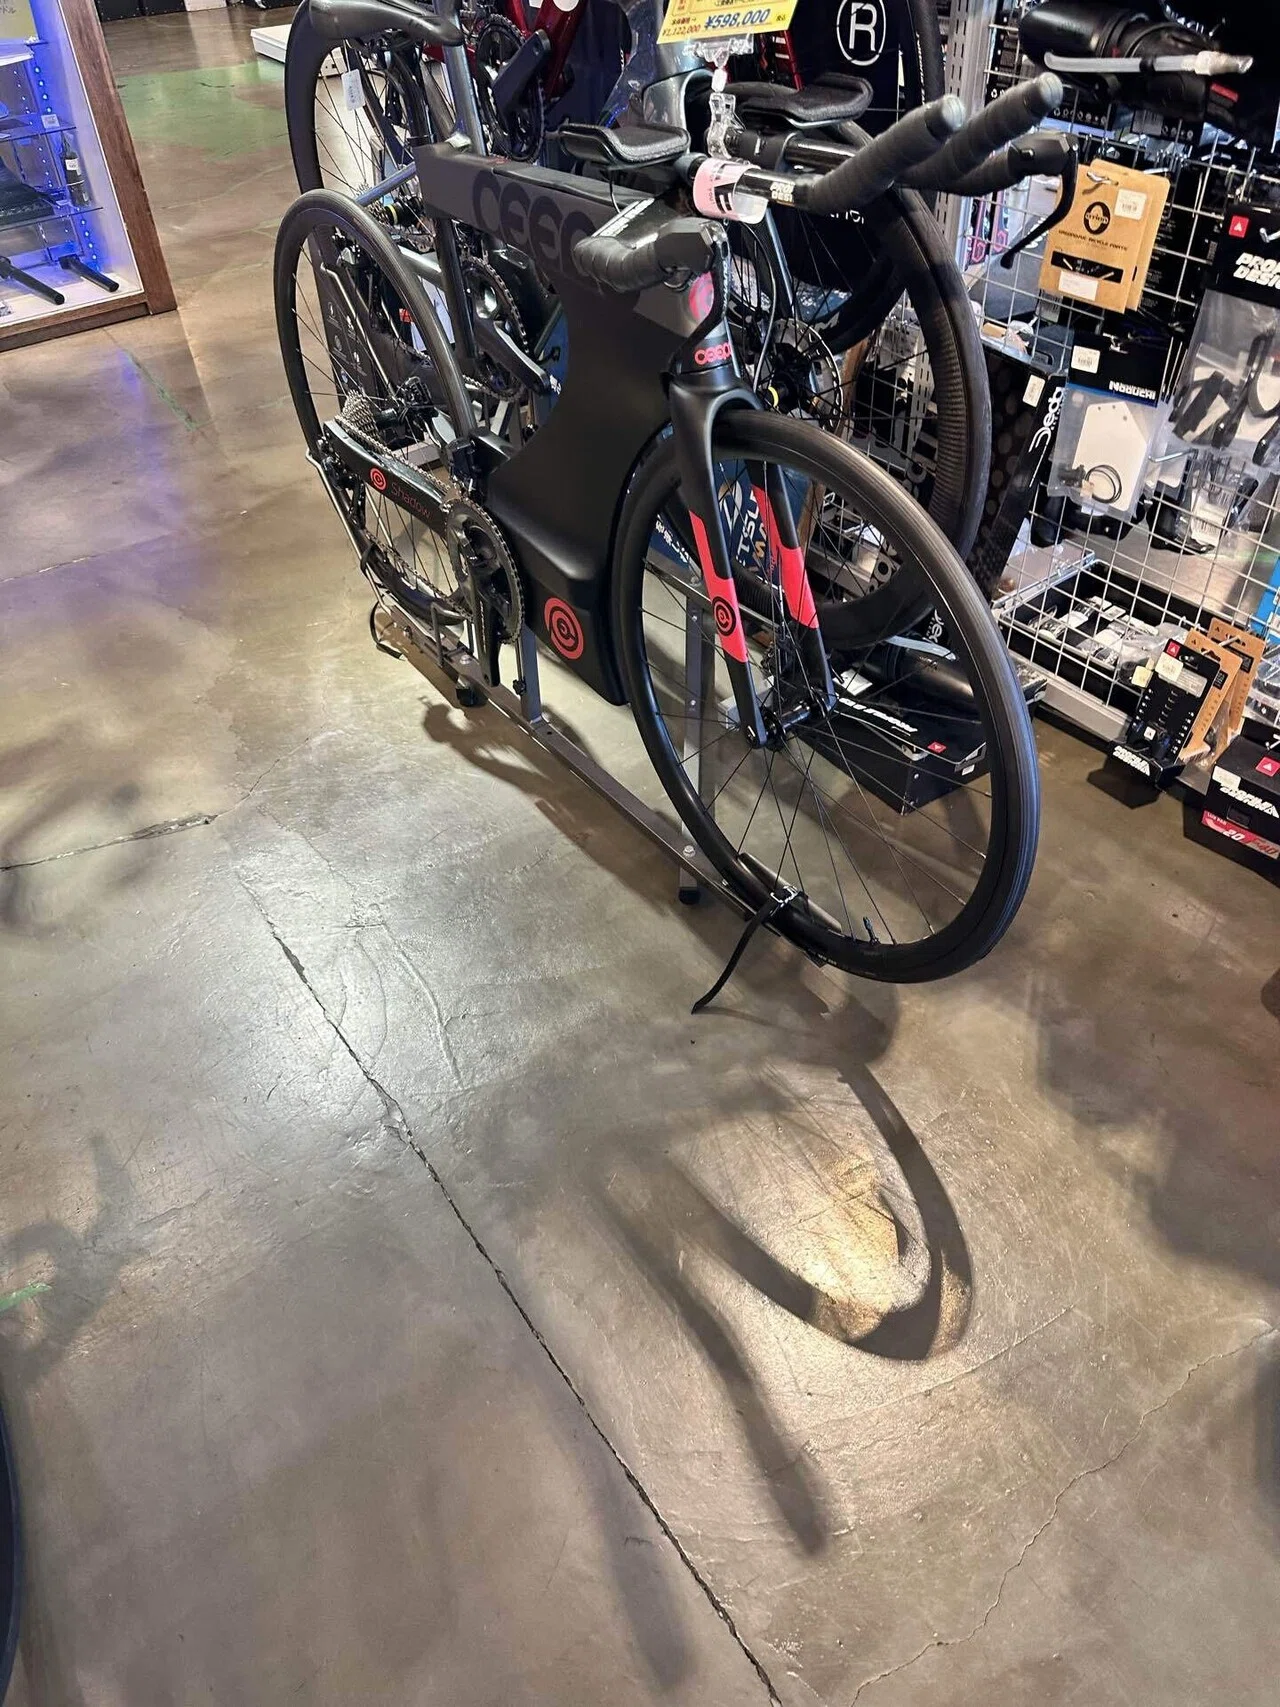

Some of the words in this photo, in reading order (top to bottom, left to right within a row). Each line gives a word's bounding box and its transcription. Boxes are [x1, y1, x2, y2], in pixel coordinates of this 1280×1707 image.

[704, 8, 771, 30] ¥598,000
[662, 24, 701, 37] ¥1,122,000
[1109, 380, 1156, 400] NOGUCHI
